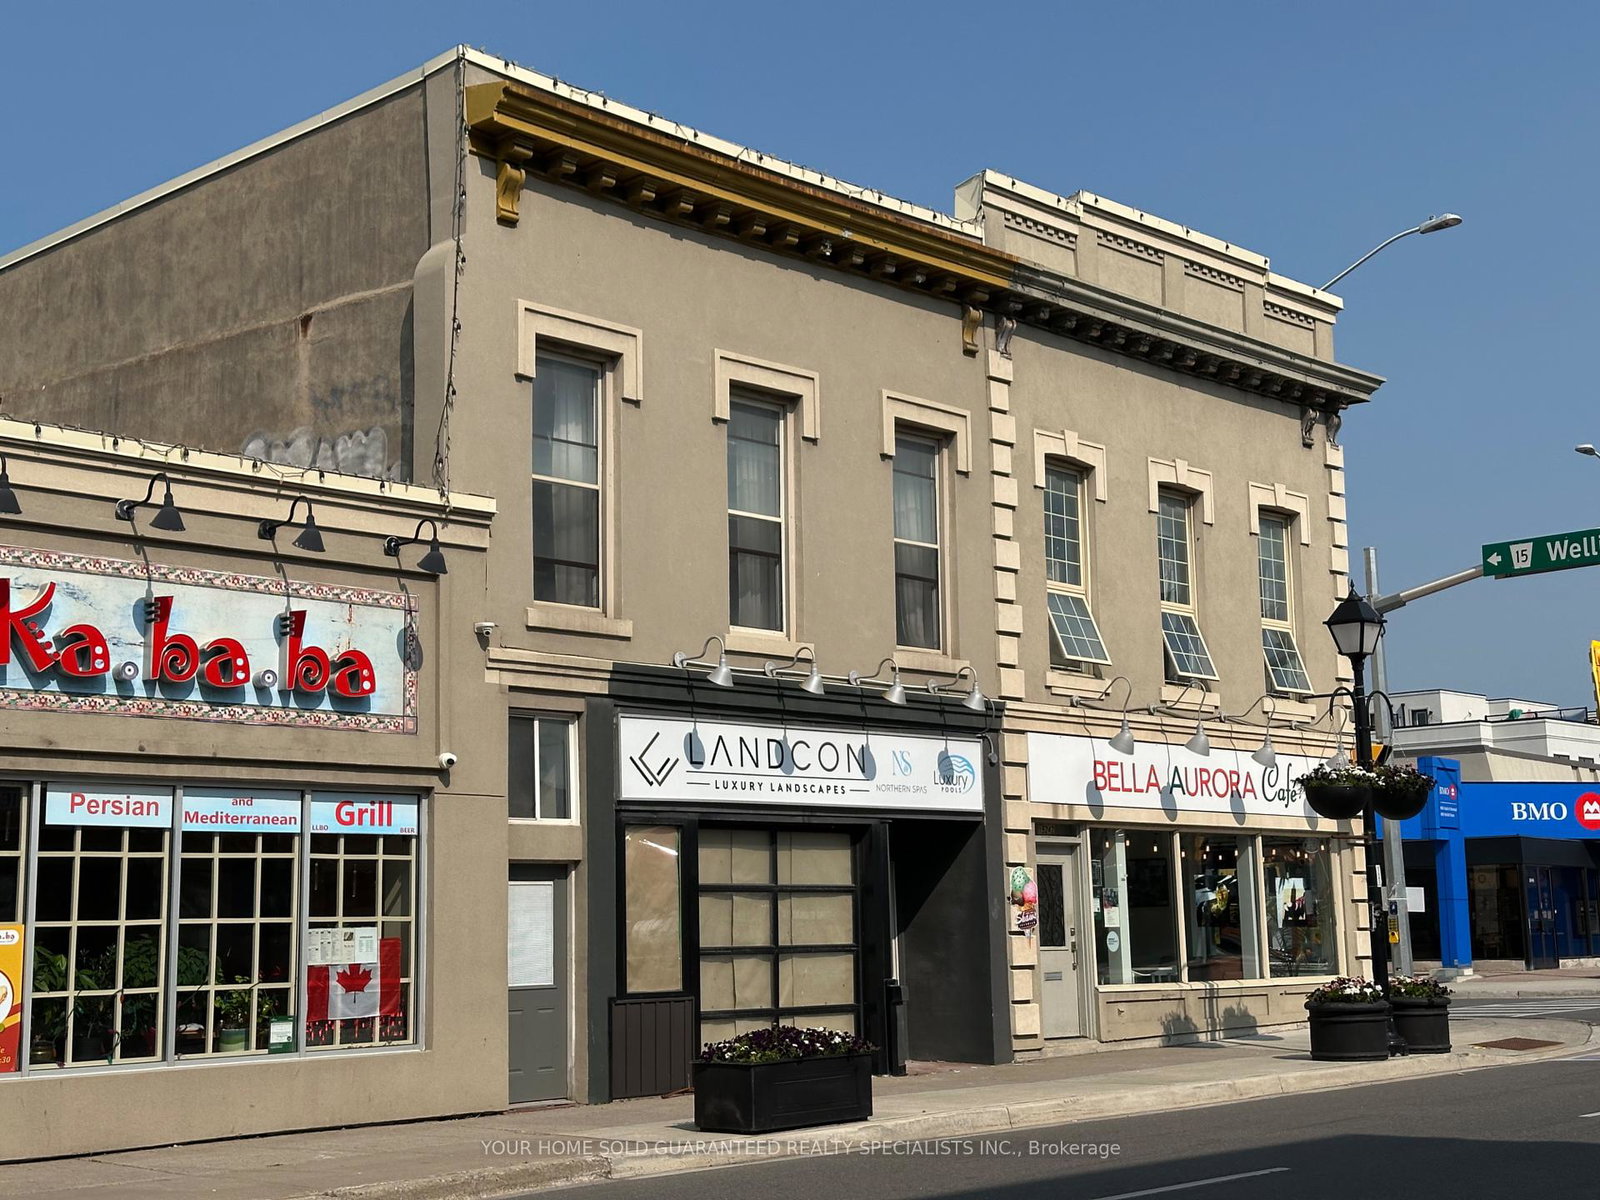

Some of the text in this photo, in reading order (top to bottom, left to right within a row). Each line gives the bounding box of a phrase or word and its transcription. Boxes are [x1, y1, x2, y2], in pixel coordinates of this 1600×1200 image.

[1516, 549, 1528, 563] 15
[689, 732, 866, 773] LANDCON
[714, 779, 846, 796] LUXURY LANDSCAPES
[933, 770, 968, 789] Luxury
[1093, 760, 1161, 794] BELLA
[1169, 766, 1257, 800] AURORA
[876, 784, 927, 794] NORTHERN SPAS
[70, 793, 160, 817] Persian
[231, 797, 253, 807] and
[1512, 802, 1568, 820] BMO
[184, 810, 298, 826] Mediterranean
[335, 800, 393, 827] Grill
